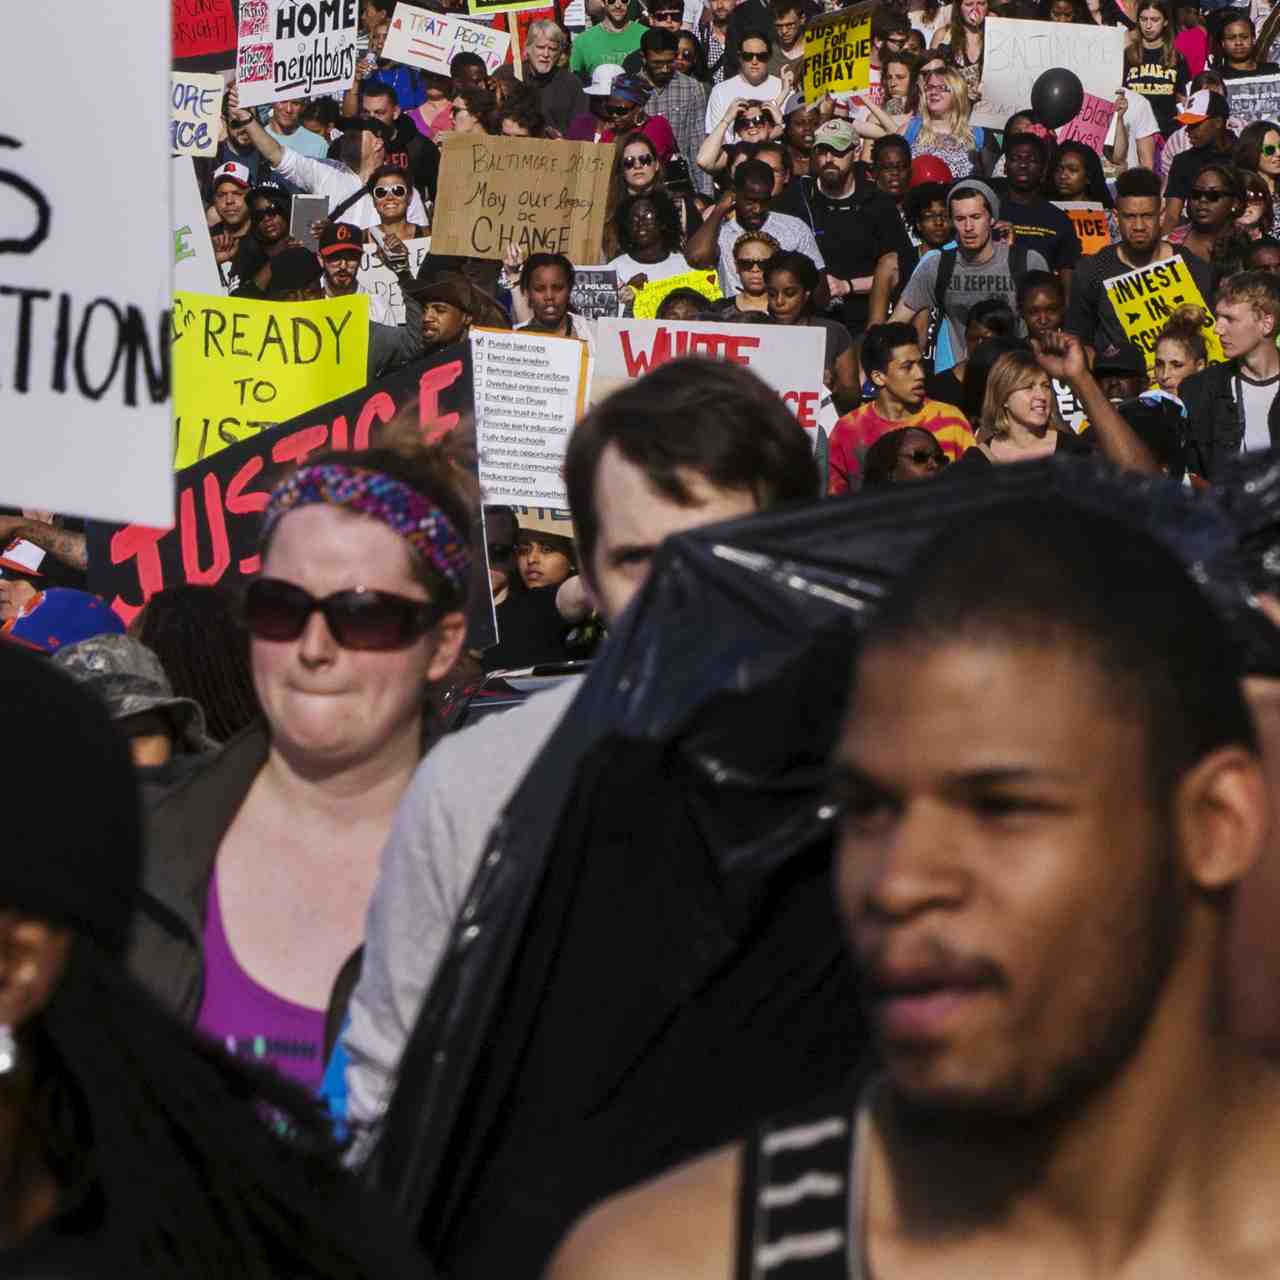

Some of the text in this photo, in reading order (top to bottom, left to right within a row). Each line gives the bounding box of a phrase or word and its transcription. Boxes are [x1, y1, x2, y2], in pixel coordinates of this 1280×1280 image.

[454, 25, 497, 50] PEOPLE
[806, 16, 870, 43] JUSTICE
[824, 32, 847, 51] FOR
[804, 38, 871, 72] FREDDIE
[987, 28, 1118, 71] BALTIMORE
[274, 37, 355, 94] neighbors
[813, 62, 855, 88] GRAY
[472, 143, 560, 173] BALTIMORE
[464, 181, 507, 216] May
[518, 190, 555, 210] our
[471, 216, 572, 256] CHANGE
[584, 283, 613, 291] POLICE
[1112, 260, 1184, 305] INVEST
[1143, 296, 1167, 320] IN
[201, 308, 353, 365] READY
[486, 353, 506, 363] Elect
[522, 357, 550, 367] leaders
[486, 366, 570, 381] Reform police practices
[233, 377, 277, 406] TO
[485, 379, 518, 390] Overhaul
[542, 385, 569, 394] system
[484, 392, 500, 402] End
[500, 394, 514, 402] War
[526, 396, 547, 406] Drugs
[483, 406, 513, 415] Restore
[513, 408, 530, 417] trust
[482, 432, 546, 446] Fully fund schools
[511, 422, 529, 432] early
[529, 422, 567, 433] education
[481, 471, 537, 485] Reduce poverty
[511, 488, 534, 497] future
[535, 490, 568, 500] together
